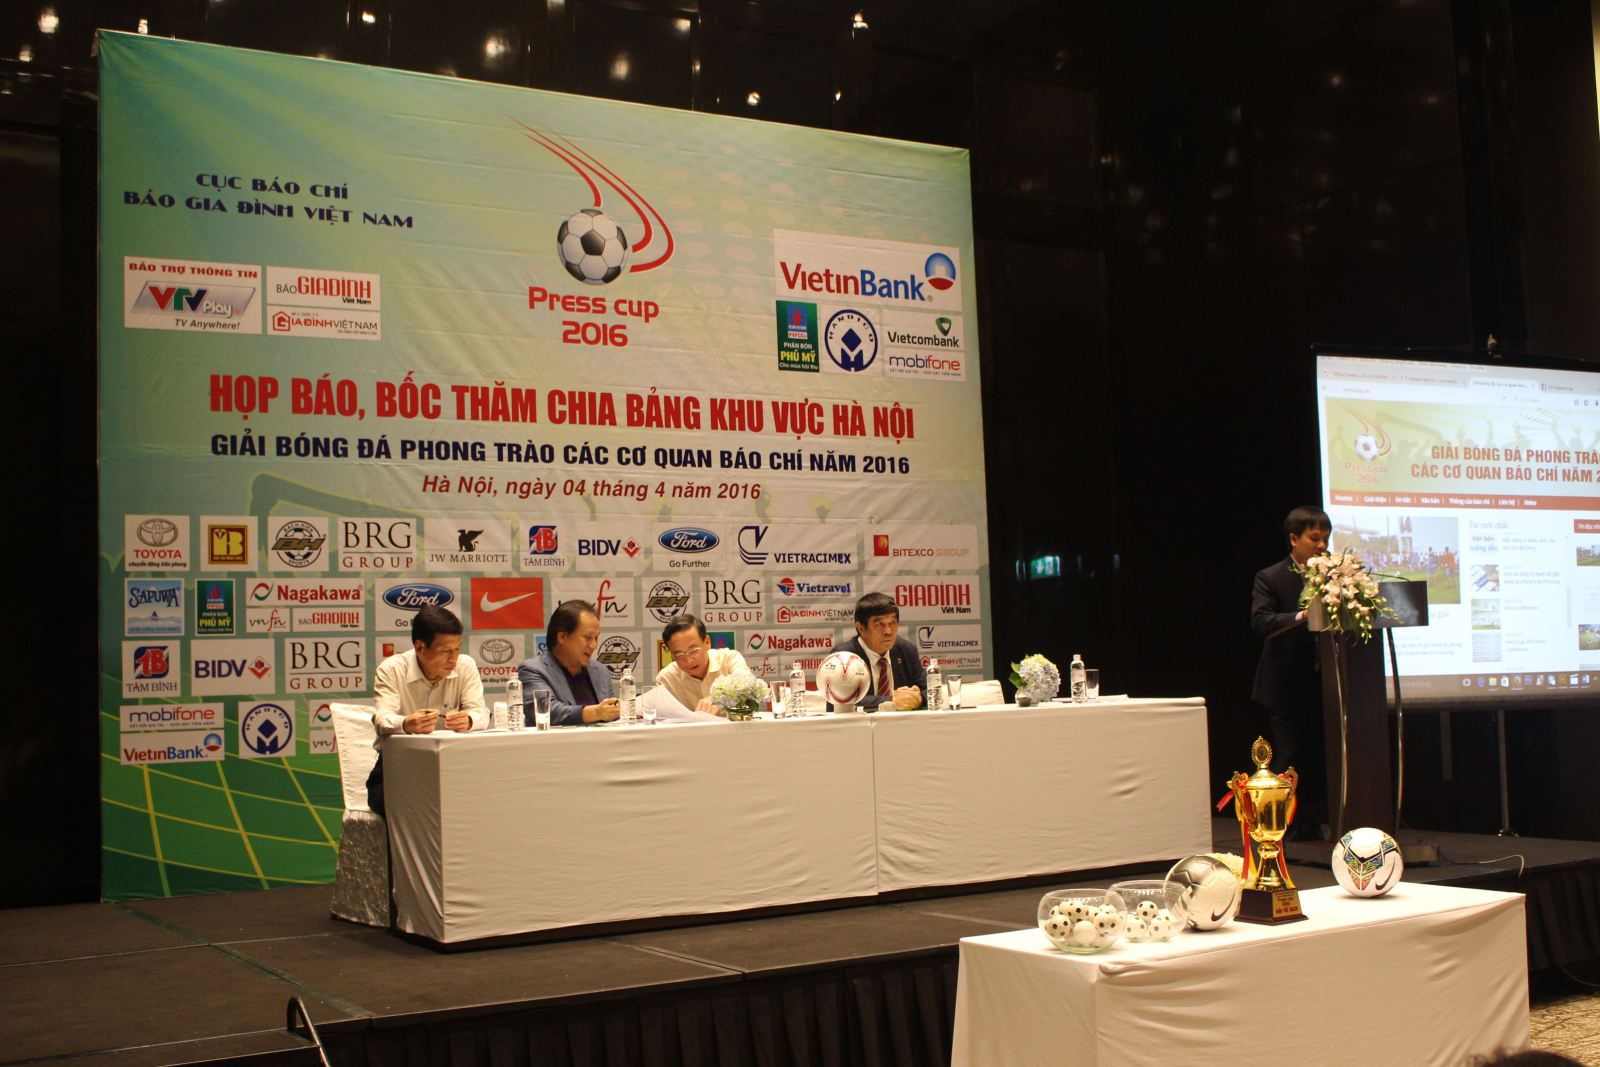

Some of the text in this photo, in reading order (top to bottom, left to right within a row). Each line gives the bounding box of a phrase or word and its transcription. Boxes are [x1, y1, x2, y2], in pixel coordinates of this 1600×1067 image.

[195, 173, 348, 199] CỤC BÁO CHÍ
[123, 189, 413, 228] BÁO GIA ĐÌNH VIỆT NAM
[237, 270, 257, 279] TIN
[779, 261, 926, 301] VietinBank
[148, 286, 233, 319] VTV Play
[528, 286, 659, 323] Press cup
[175, 319, 240, 330] TV Anywhere!
[562, 320, 628, 347] 2016
[887, 331, 960, 348] Vietcombank
[780, 350, 799, 361] PHÚ
[889, 353, 961, 371] mobifone
[209, 370, 914, 444] HỌP BÁO, BỐC THĂM CHIA BẢNG KHU VỰC HÀ NỘI
[211, 428, 910, 475] GIẢI BÓNG ĐÁ PHONG TRÀO CÁC CƠ QUAN BÁO CHÍ NĂM 2016
[1431, 442, 1600, 465] GIẢI BÓNG ĐÁ PHONG TRÀ
[1411, 460, 1440, 478] CÁC
[1443, 463, 1462, 479] CƠ
[1466, 465, 1501, 481] QUAN
[1505, 465, 1532, 481] BÁO
[1536, 466, 1558, 482] CHÍ
[1562, 466, 1593, 482] NĂM
[422, 475, 761, 501] Hà Nội, ngày 04 tháng 4 năm 2016
[342, 521, 411, 549] BRG
[670, 530, 707, 549] Ford
[134, 549, 182, 559] TOYOTA
[577, 539, 621, 556] BIDV
[892, 548, 934, 557] BITEXCO
[342, 556, 413, 569] GROUP
[429, 554, 507, 563] JW MARRIOTT
[669, 560, 711, 568] Go Further
[773, 552, 851, 565] VIETRACIMEX
[277, 584, 361, 603] Nagakawa
[704, 580, 761, 605] BRG
[796, 582, 851, 593] Vietravel
[128, 587, 179, 608] SAPUWA
[396, 588, 440, 606] Ford
[395, 619, 409, 627] Go
[704, 612, 763, 623] GROUP
[767, 634, 833, 651] Nagakawa
[290, 641, 361, 670] BRG
[194, 659, 248, 679] BIDV
[290, 677, 363, 690] GROUP
[129, 706, 215, 723] mobifone
[123, 745, 204, 762] VietinBank
